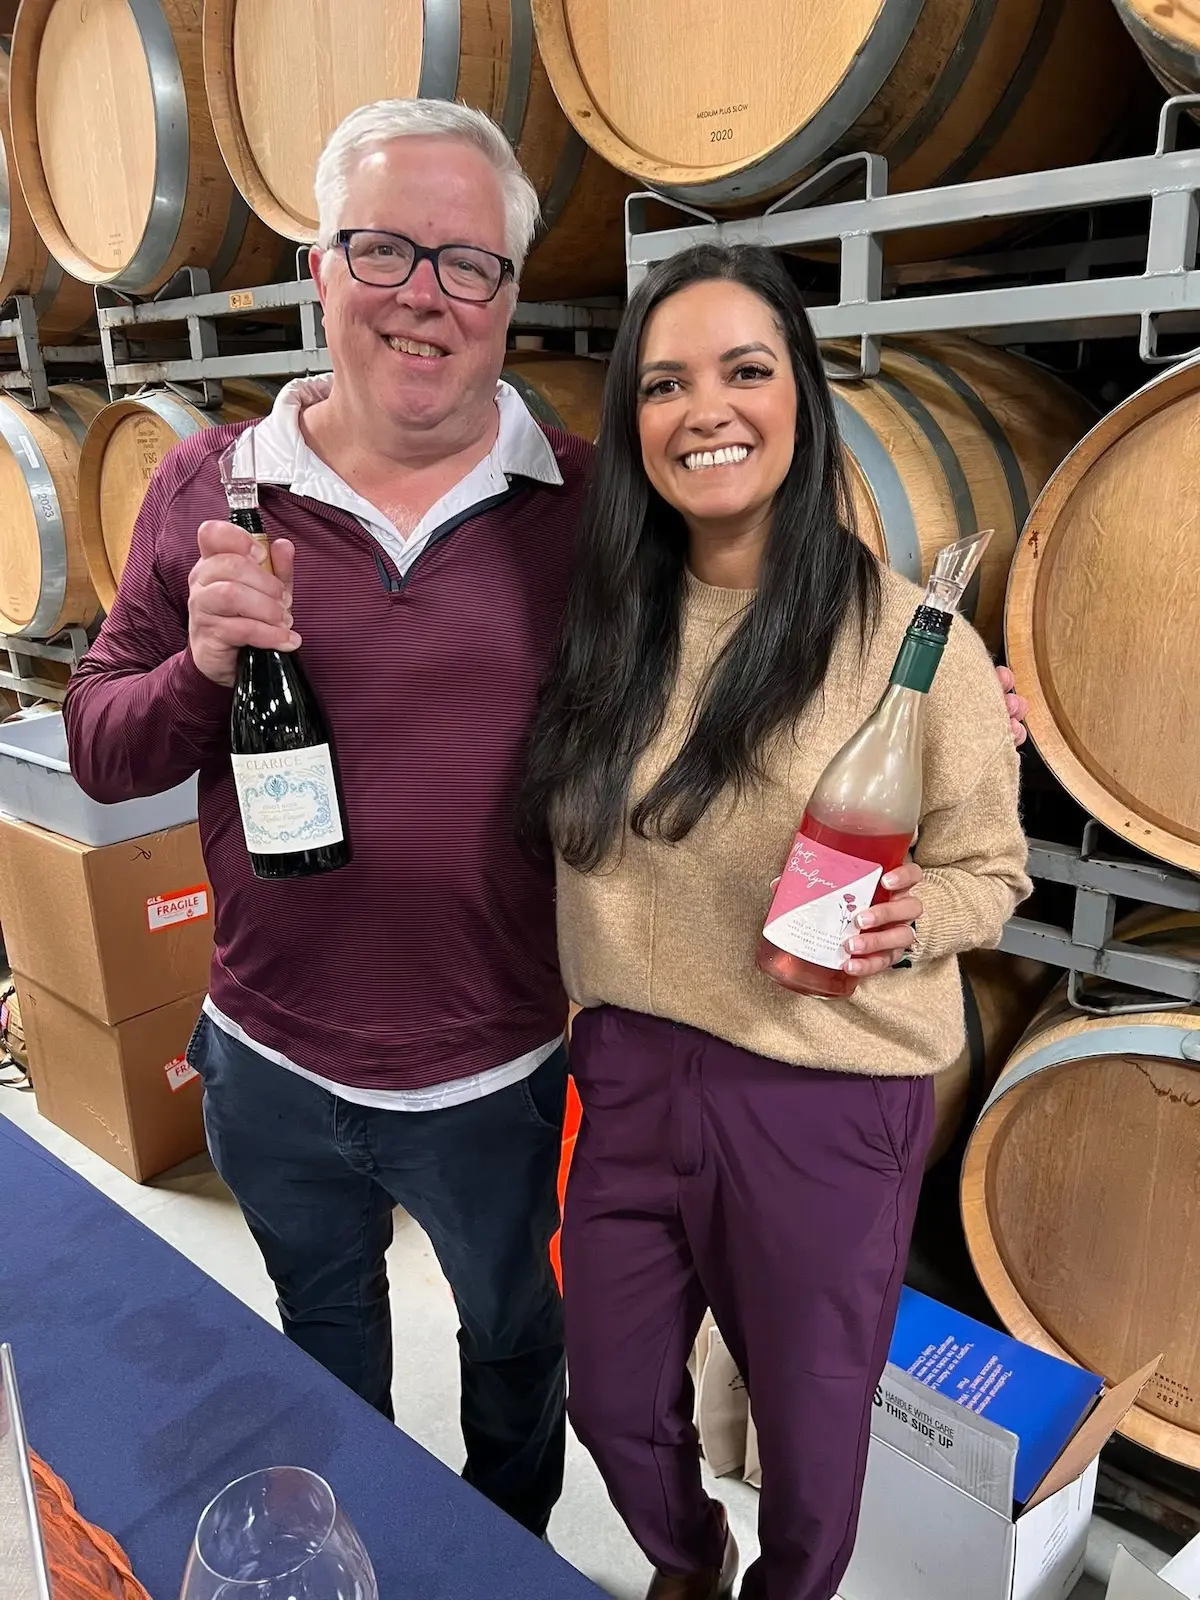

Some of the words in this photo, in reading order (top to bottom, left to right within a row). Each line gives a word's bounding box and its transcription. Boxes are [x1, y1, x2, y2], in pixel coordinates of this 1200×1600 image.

[696, 110, 718, 119] MEDIUM
[719, 106, 731, 115] PLUS
[732, 103, 749, 113] SLOW
[710, 128, 733, 143] 2020
[36, 493, 55, 518] 2023
[246, 756, 301, 771] CLARICE
[156, 896, 200, 916] FRAGILE
[1156, 1392, 1179, 1407] 2023
[885, 1390, 913, 1413] HANDLE
[914, 1408, 933, 1425] WITH
[934, 1419, 954, 1437] CARE
[885, 1401, 908, 1423] THIS
[911, 1418, 935, 1441] SIDE
[938, 1434, 953, 1449] UP
